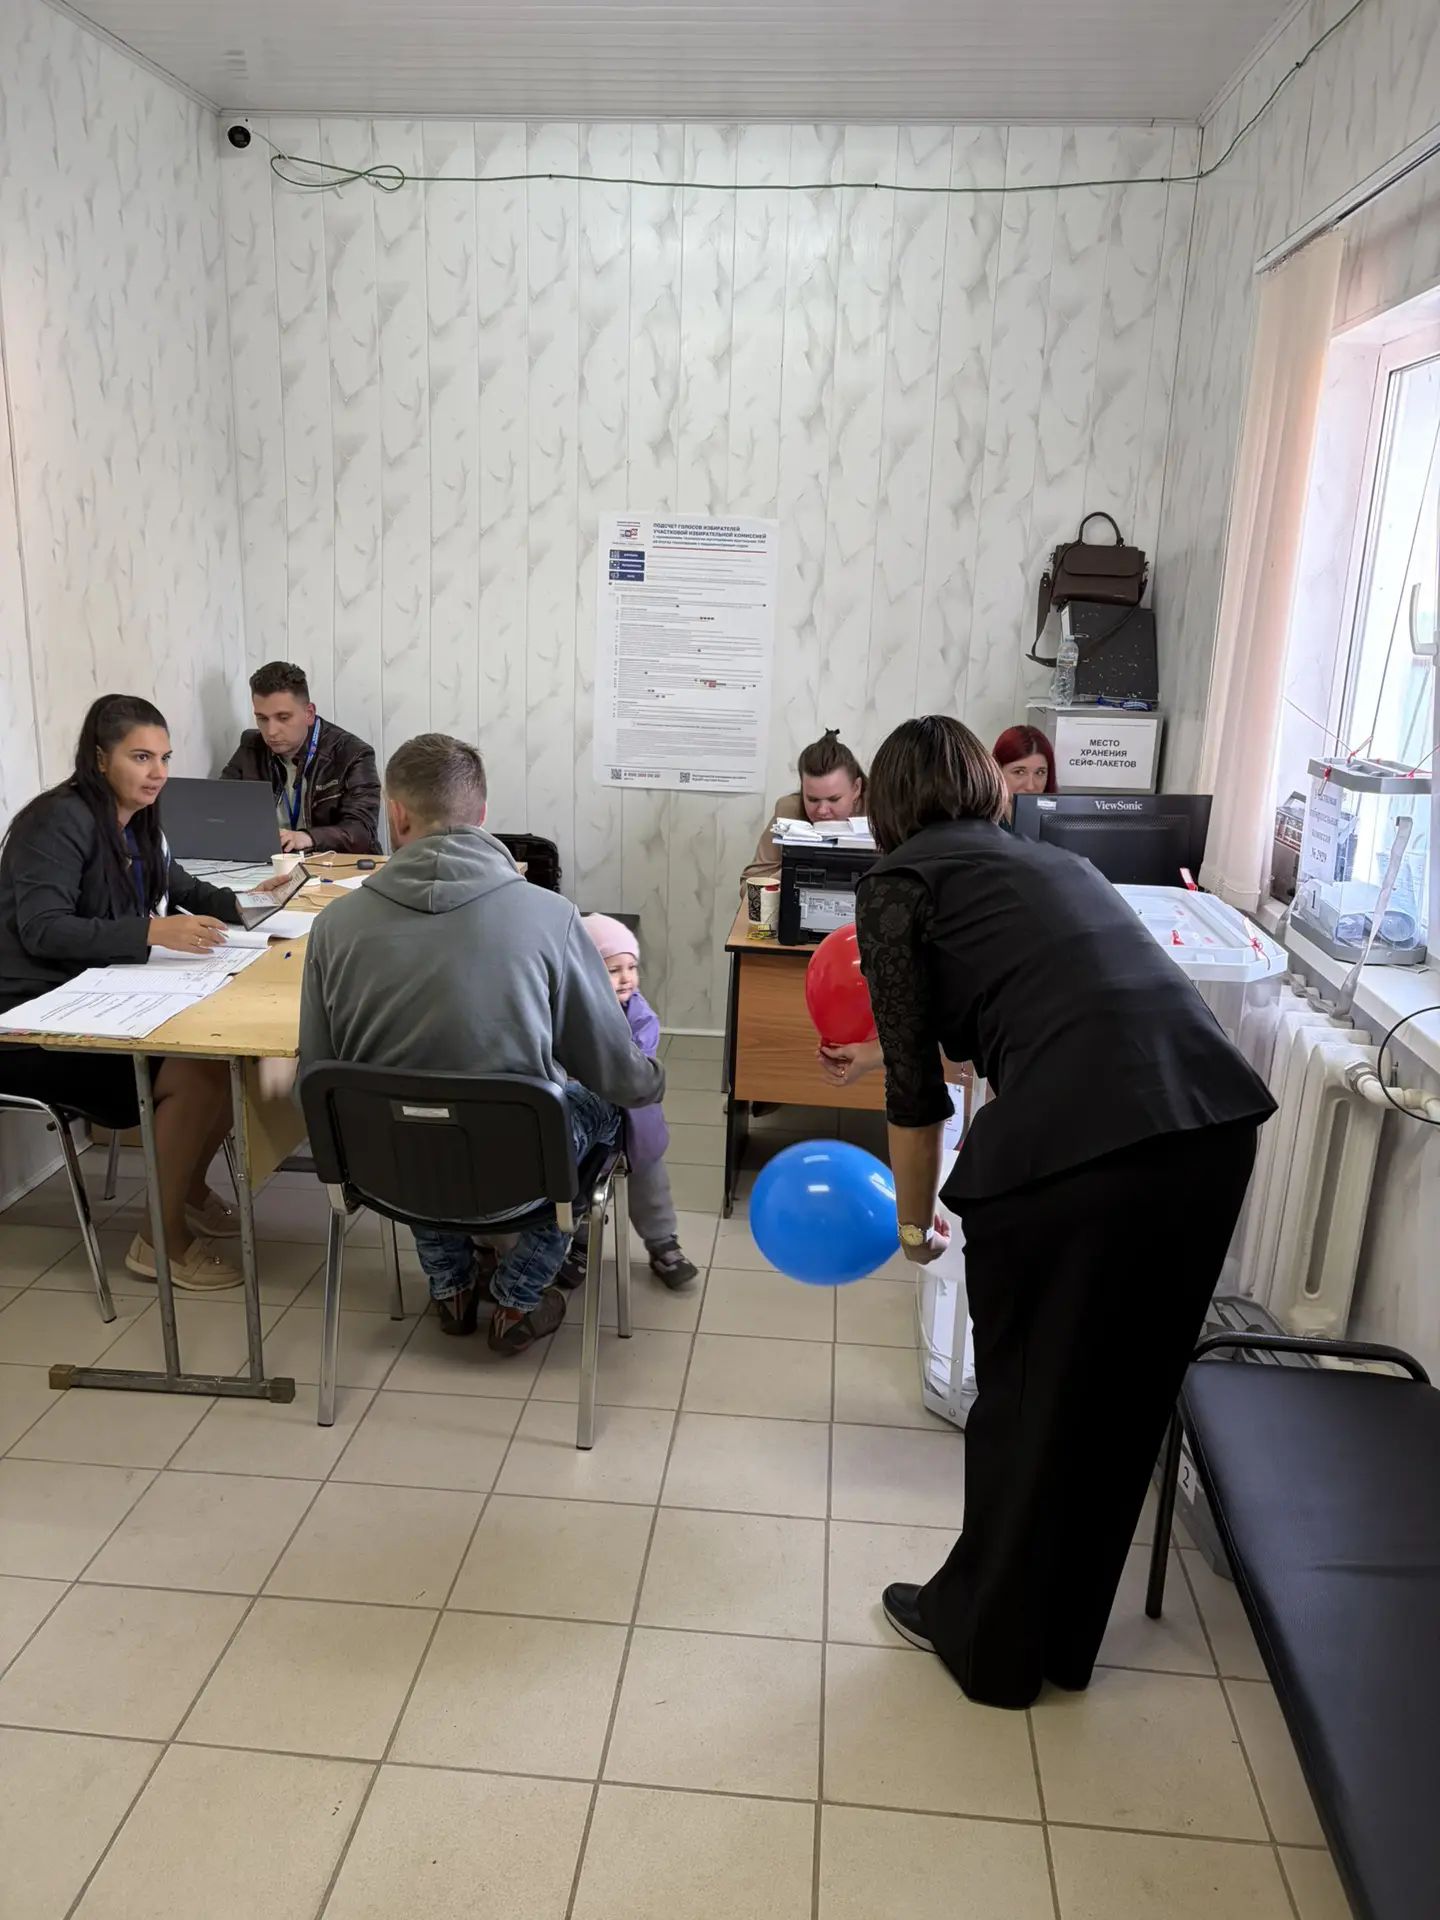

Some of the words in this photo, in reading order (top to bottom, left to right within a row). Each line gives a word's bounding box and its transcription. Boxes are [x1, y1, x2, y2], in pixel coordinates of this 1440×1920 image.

[1089, 739, 1120, 747] МЕСТО
[1080, 748, 1127, 757] ХРАНЕНИЯ
[1069, 758, 1137, 768] СЕЙФ-ПАКЕТОВ
[1094, 800, 1143, 810] ViewSonic
[1182, 1466, 1190, 1489] 2
